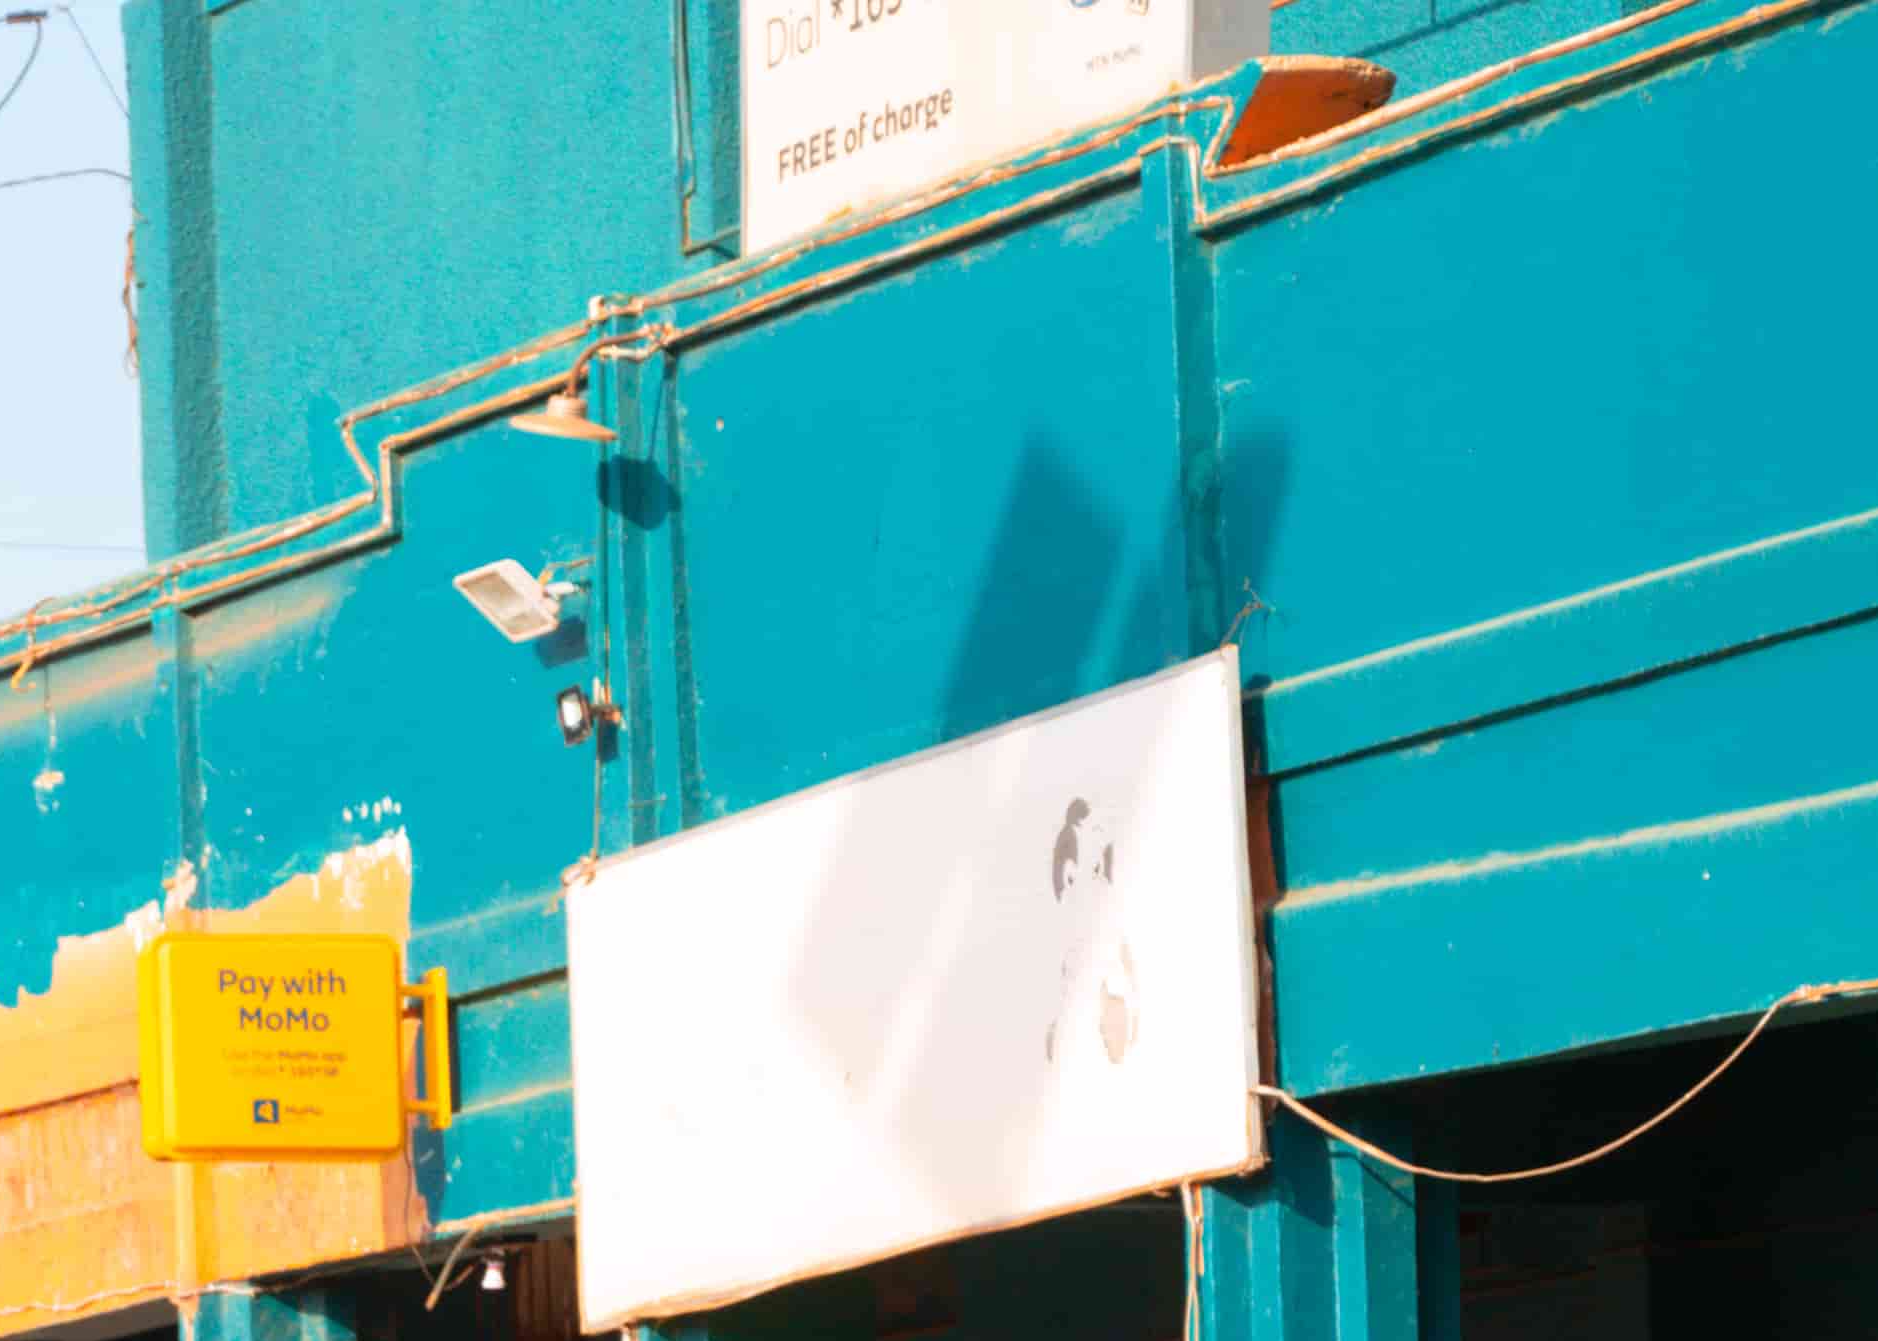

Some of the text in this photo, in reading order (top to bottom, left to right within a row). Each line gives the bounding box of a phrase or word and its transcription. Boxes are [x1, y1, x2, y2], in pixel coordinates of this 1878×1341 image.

[777, 88, 953, 184] FREE of charge
[218, 967, 346, 1002] Pay with
[239, 1006, 329, 1032] MoMo
